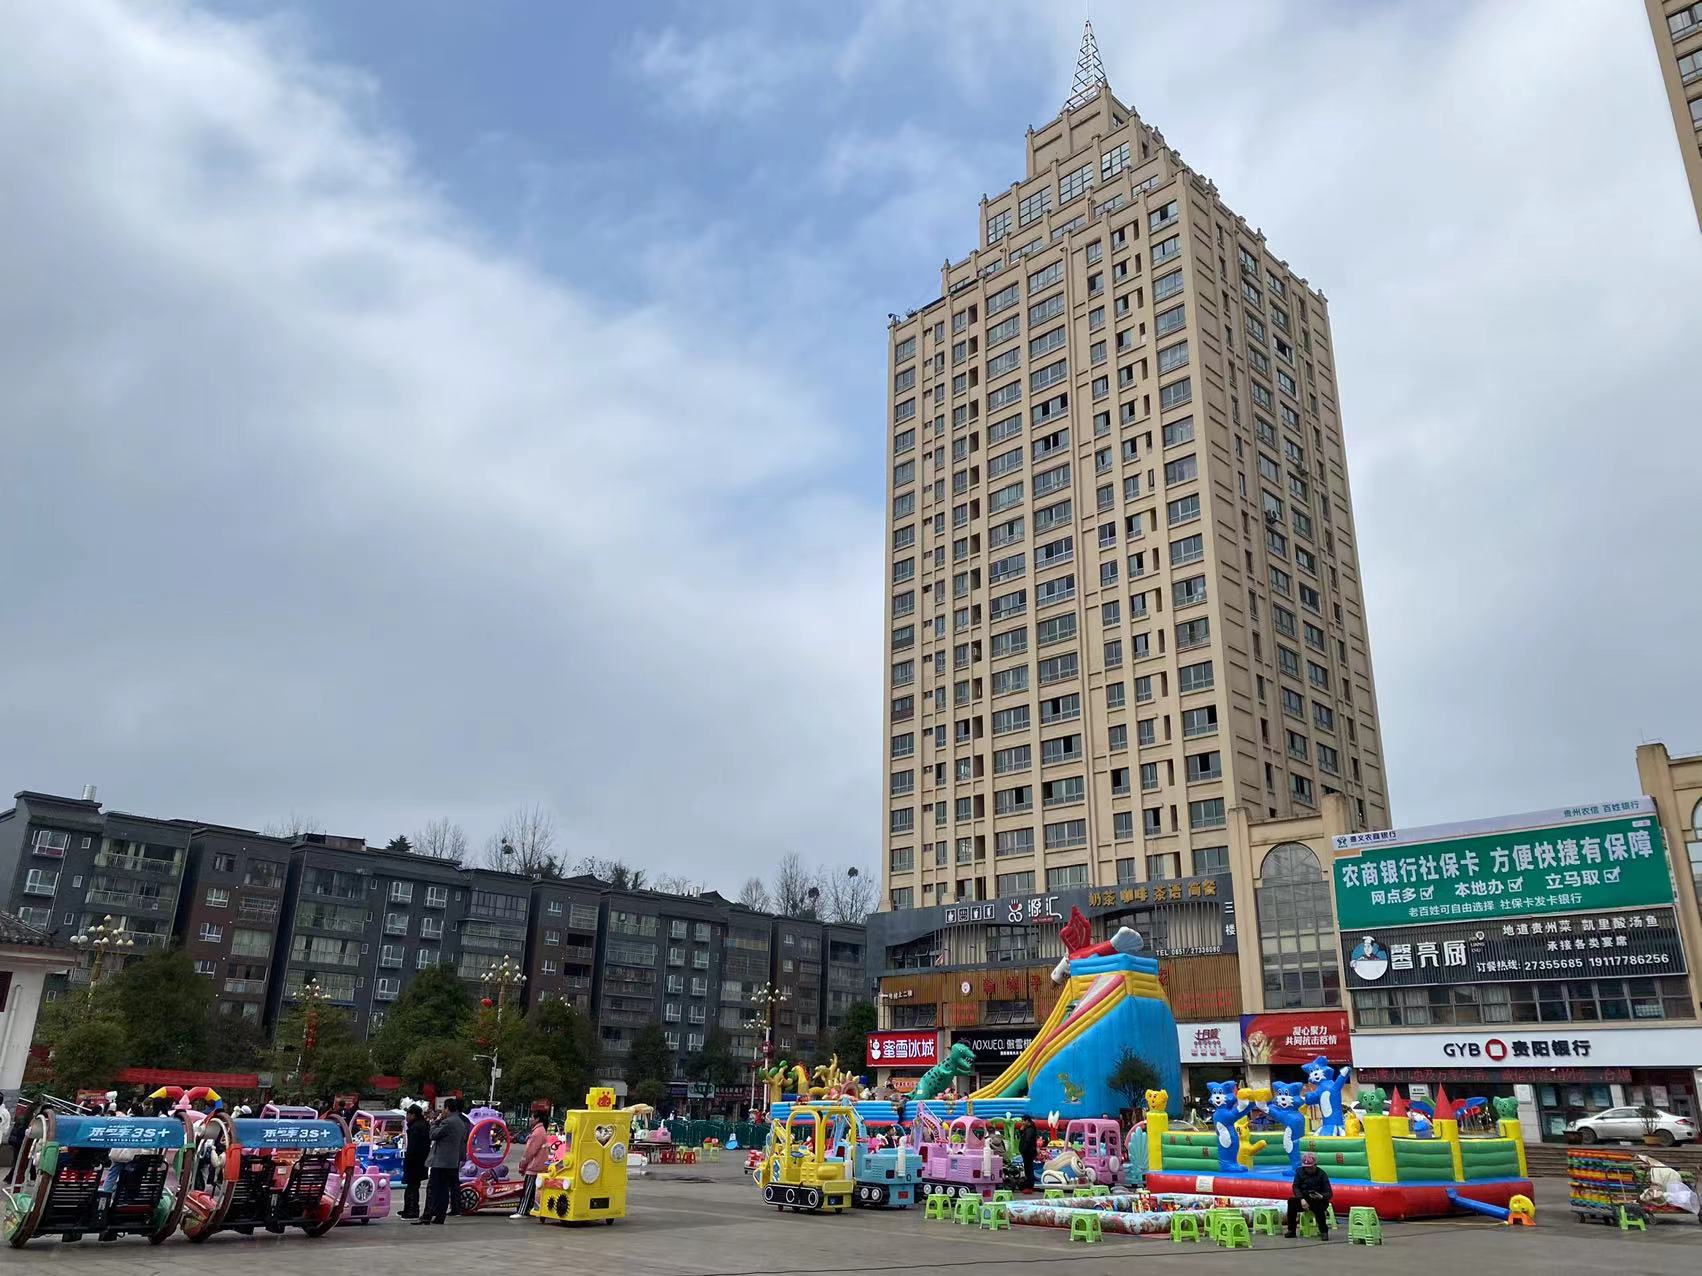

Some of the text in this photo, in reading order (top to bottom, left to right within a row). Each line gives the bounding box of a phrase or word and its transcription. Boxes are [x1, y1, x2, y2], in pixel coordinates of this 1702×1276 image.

[1342, 830, 1654, 889] 农商银行社保卡 方便快捷有保障
[1371, 870, 1600, 905] 网点多 本地办 立马取
[1408, 893, 1583, 917] 老百姓可自由选择 社保卡发卡银行
[1502, 915, 1660, 936] 地道贵州菜 凯里酸汤鱼
[1547, 935, 1628, 951] 承接各类宴席
[1390, 940, 1467, 970] 馨亮厨
[1524, 959, 1584, 971] 27355685
[1589, 954, 1670, 967] 19117786256
[882, 1039, 935, 1059] 蜜雪冰城
[1285, 1035, 1338, 1047] 共同抗击疫情
[1443, 1040, 1592, 1058] GYB 贵阳银行
